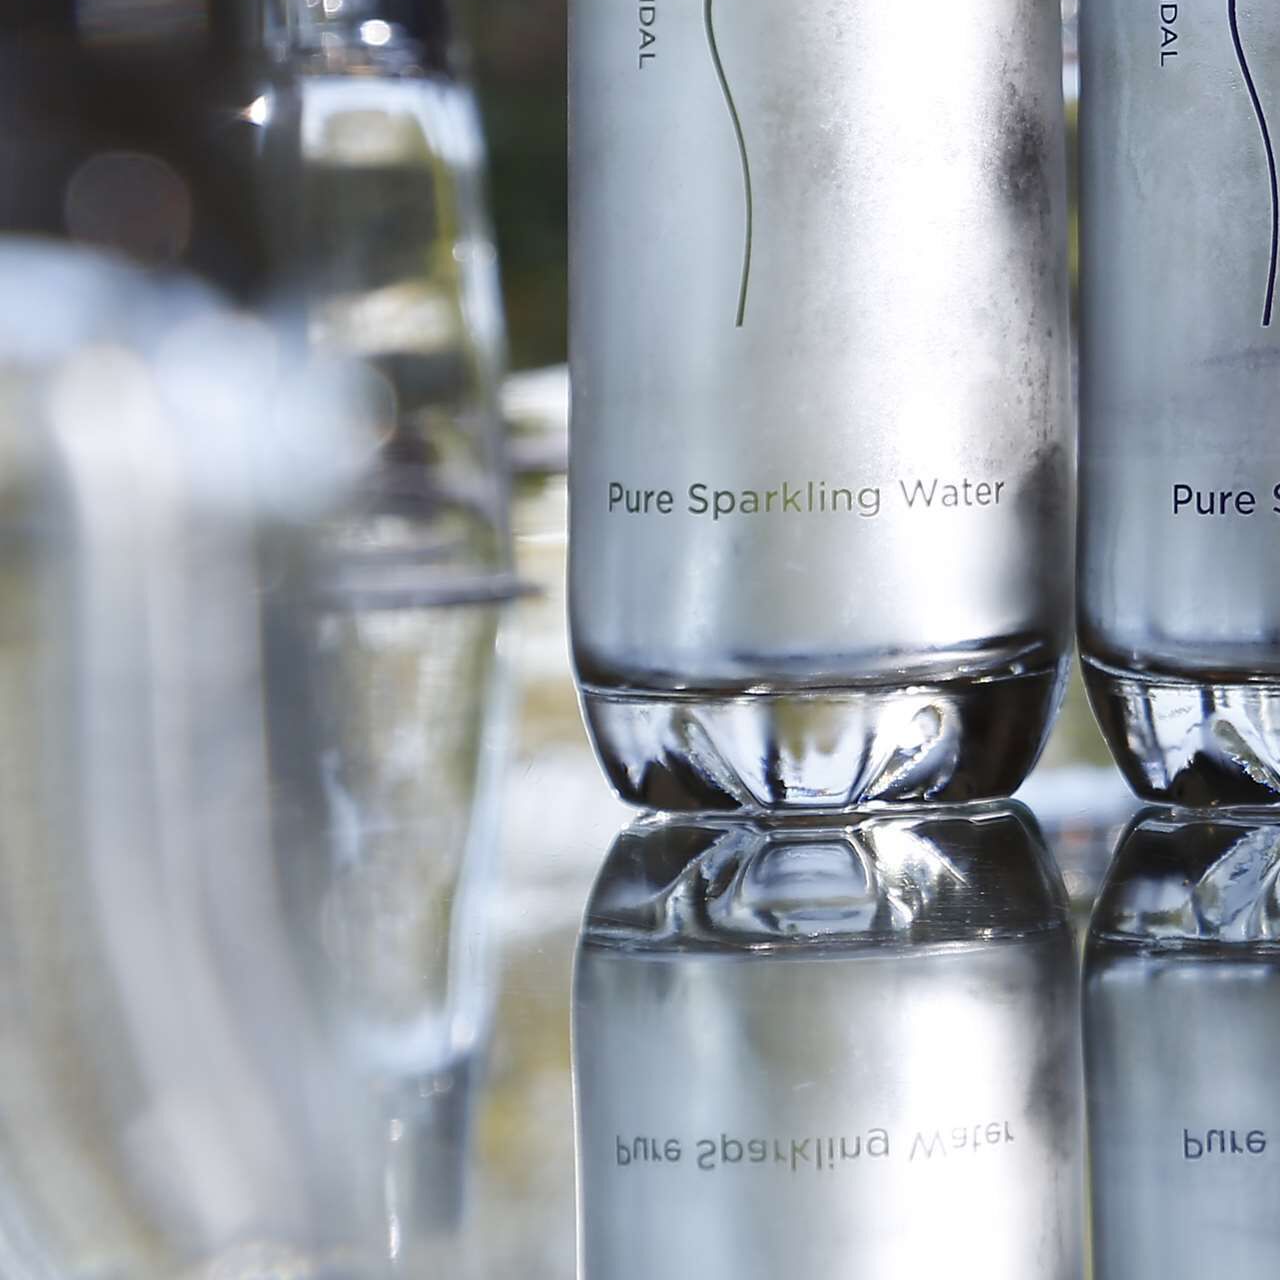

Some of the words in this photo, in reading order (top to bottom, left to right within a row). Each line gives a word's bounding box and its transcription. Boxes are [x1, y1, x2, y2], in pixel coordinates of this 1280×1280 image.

[608, 481, 674, 514] Pure
[687, 480, 881, 520] Sparkling
[899, 478, 1004, 508] Water
[1173, 483, 1256, 515] Pure
